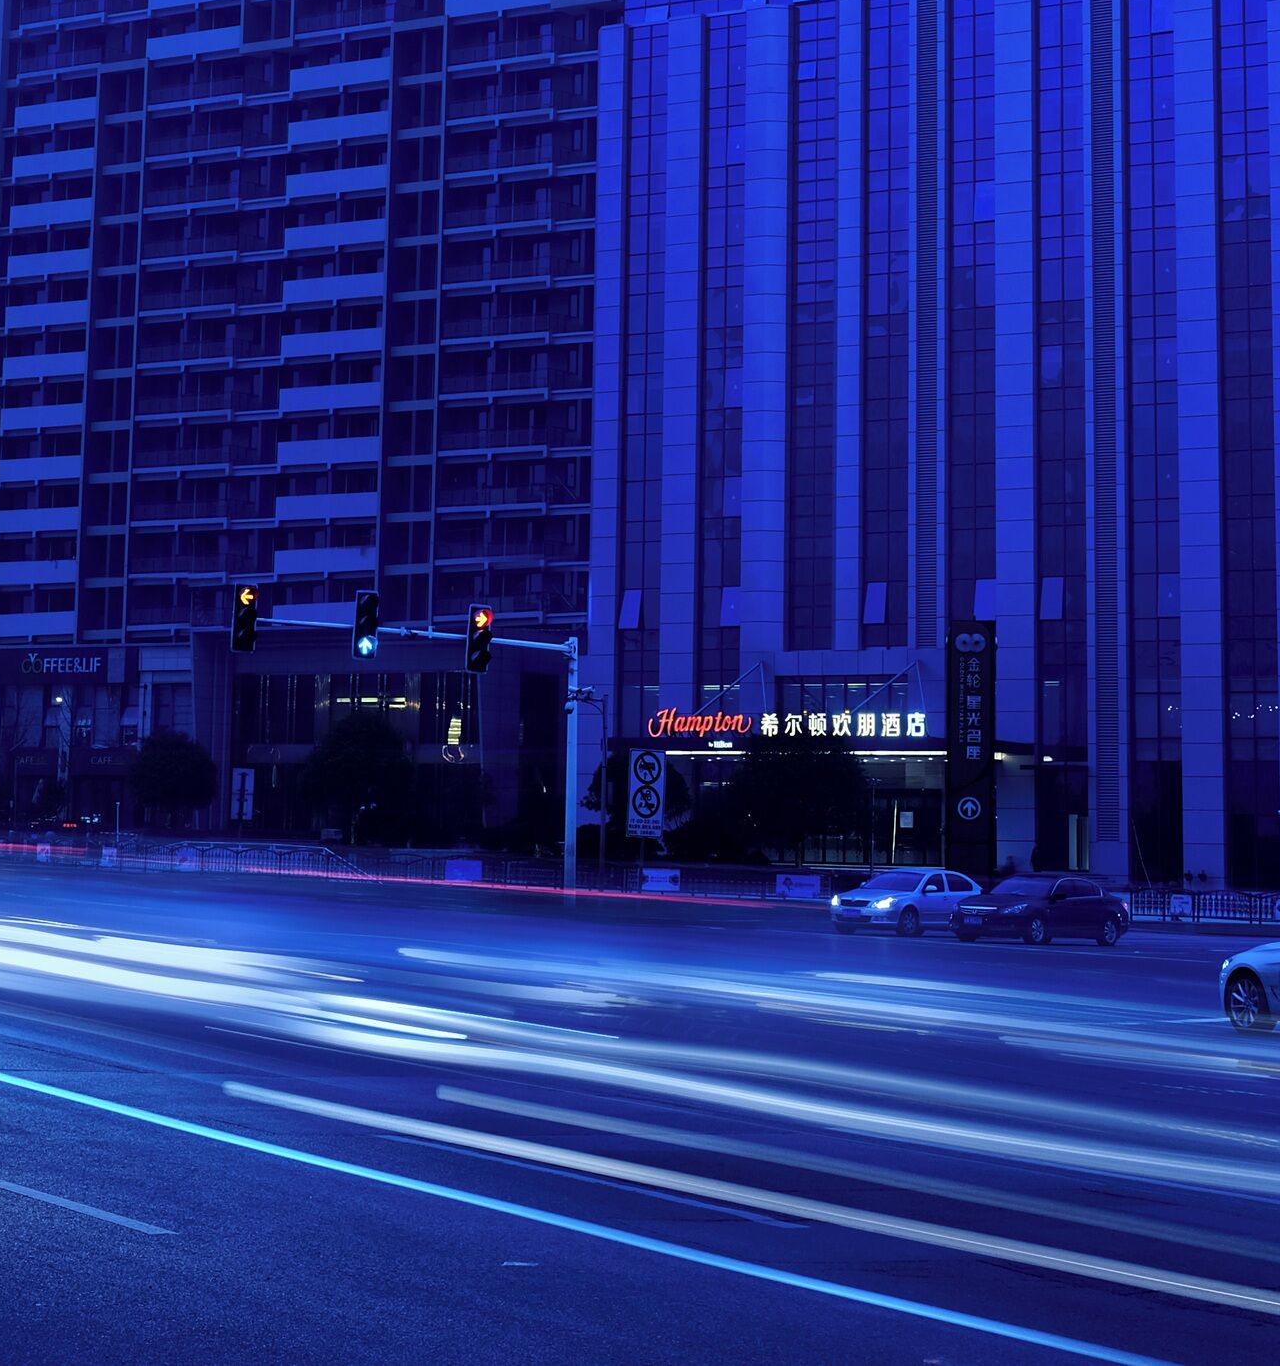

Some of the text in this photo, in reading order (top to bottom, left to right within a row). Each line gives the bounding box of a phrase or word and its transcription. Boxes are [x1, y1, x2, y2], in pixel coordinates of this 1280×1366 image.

[647, 706, 752, 738] Hampton
[760, 712, 926, 738] 希尔顿欢朋酒店
